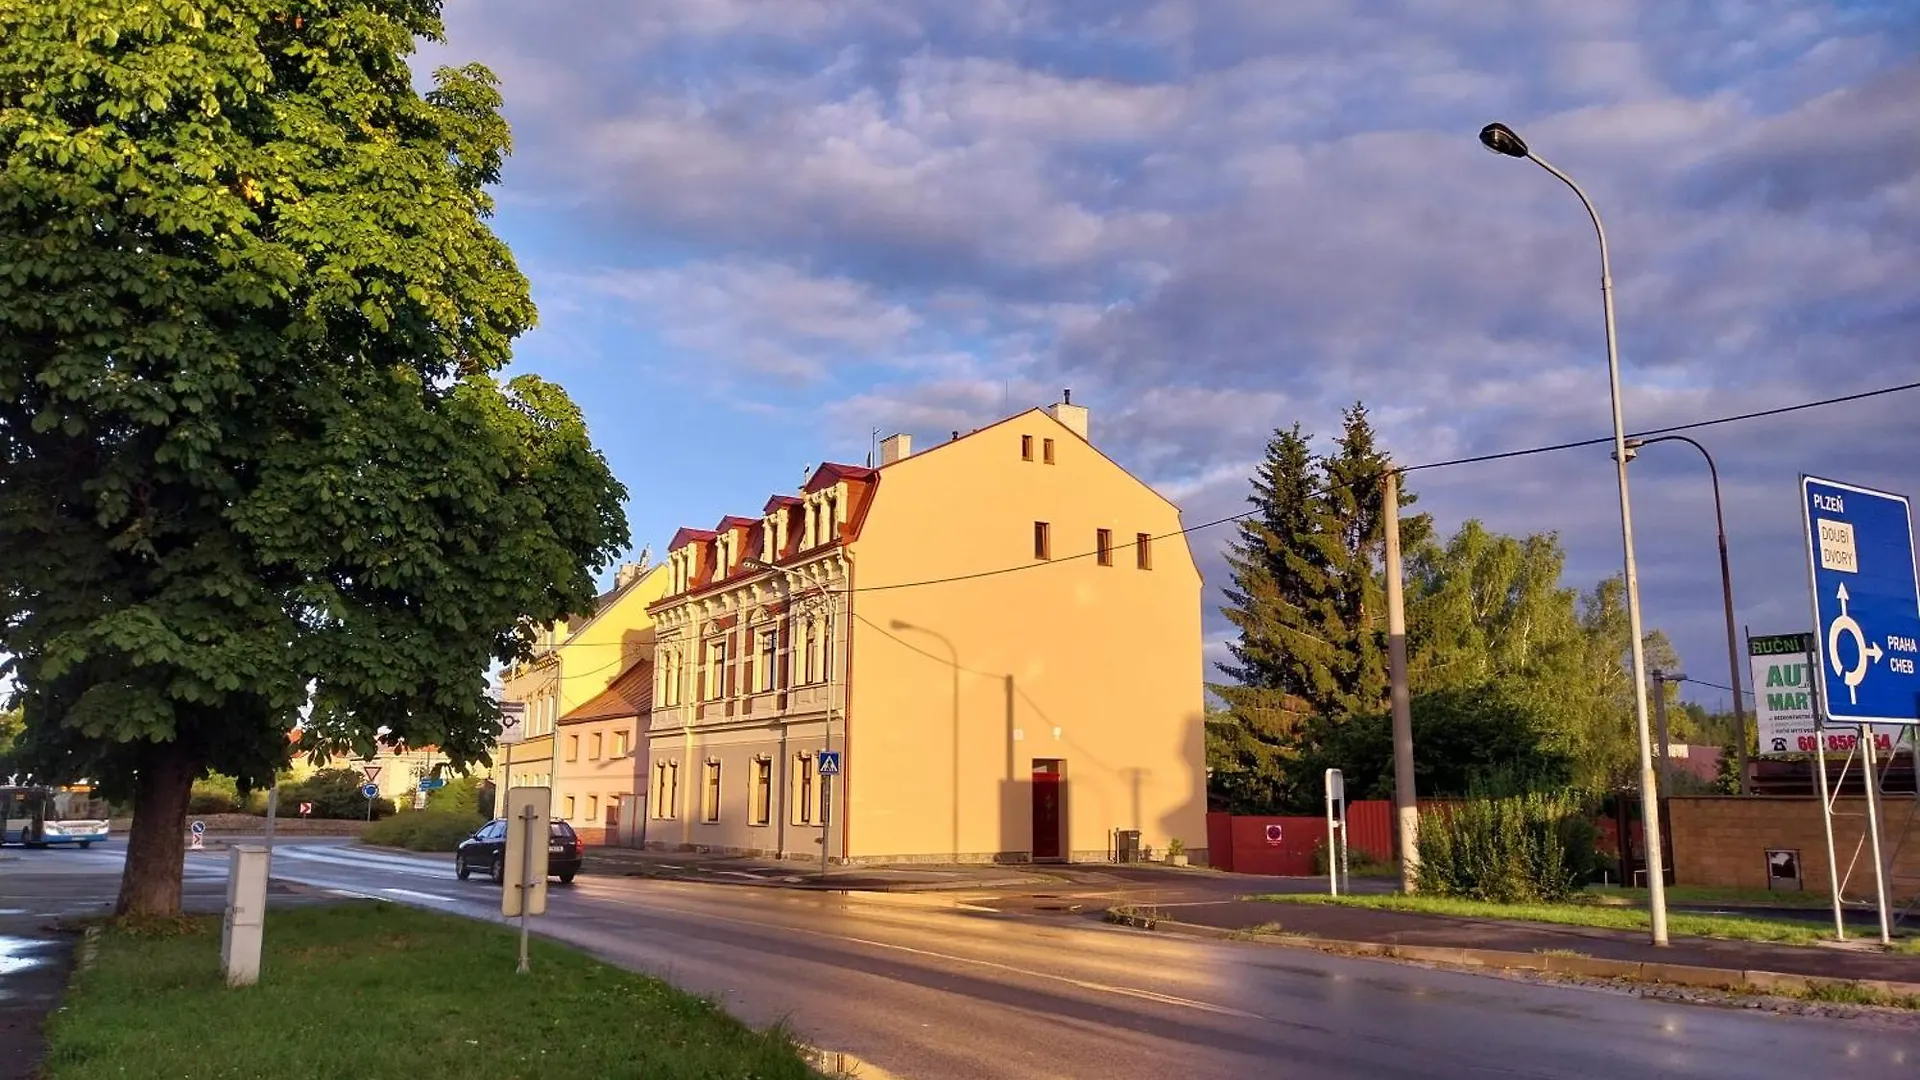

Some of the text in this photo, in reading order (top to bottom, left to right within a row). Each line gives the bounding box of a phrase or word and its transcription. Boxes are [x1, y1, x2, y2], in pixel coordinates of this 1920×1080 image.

[1813, 494, 1844, 513] PLZEŇ
[1822, 526, 1849, 543] DOUBÍ
[1824, 548, 1852, 566] DVORY
[1753, 636, 1799, 654] RUČNÍ
[1887, 636, 1918, 653] PRAHA
[1889, 657, 1914, 674] CHEB
